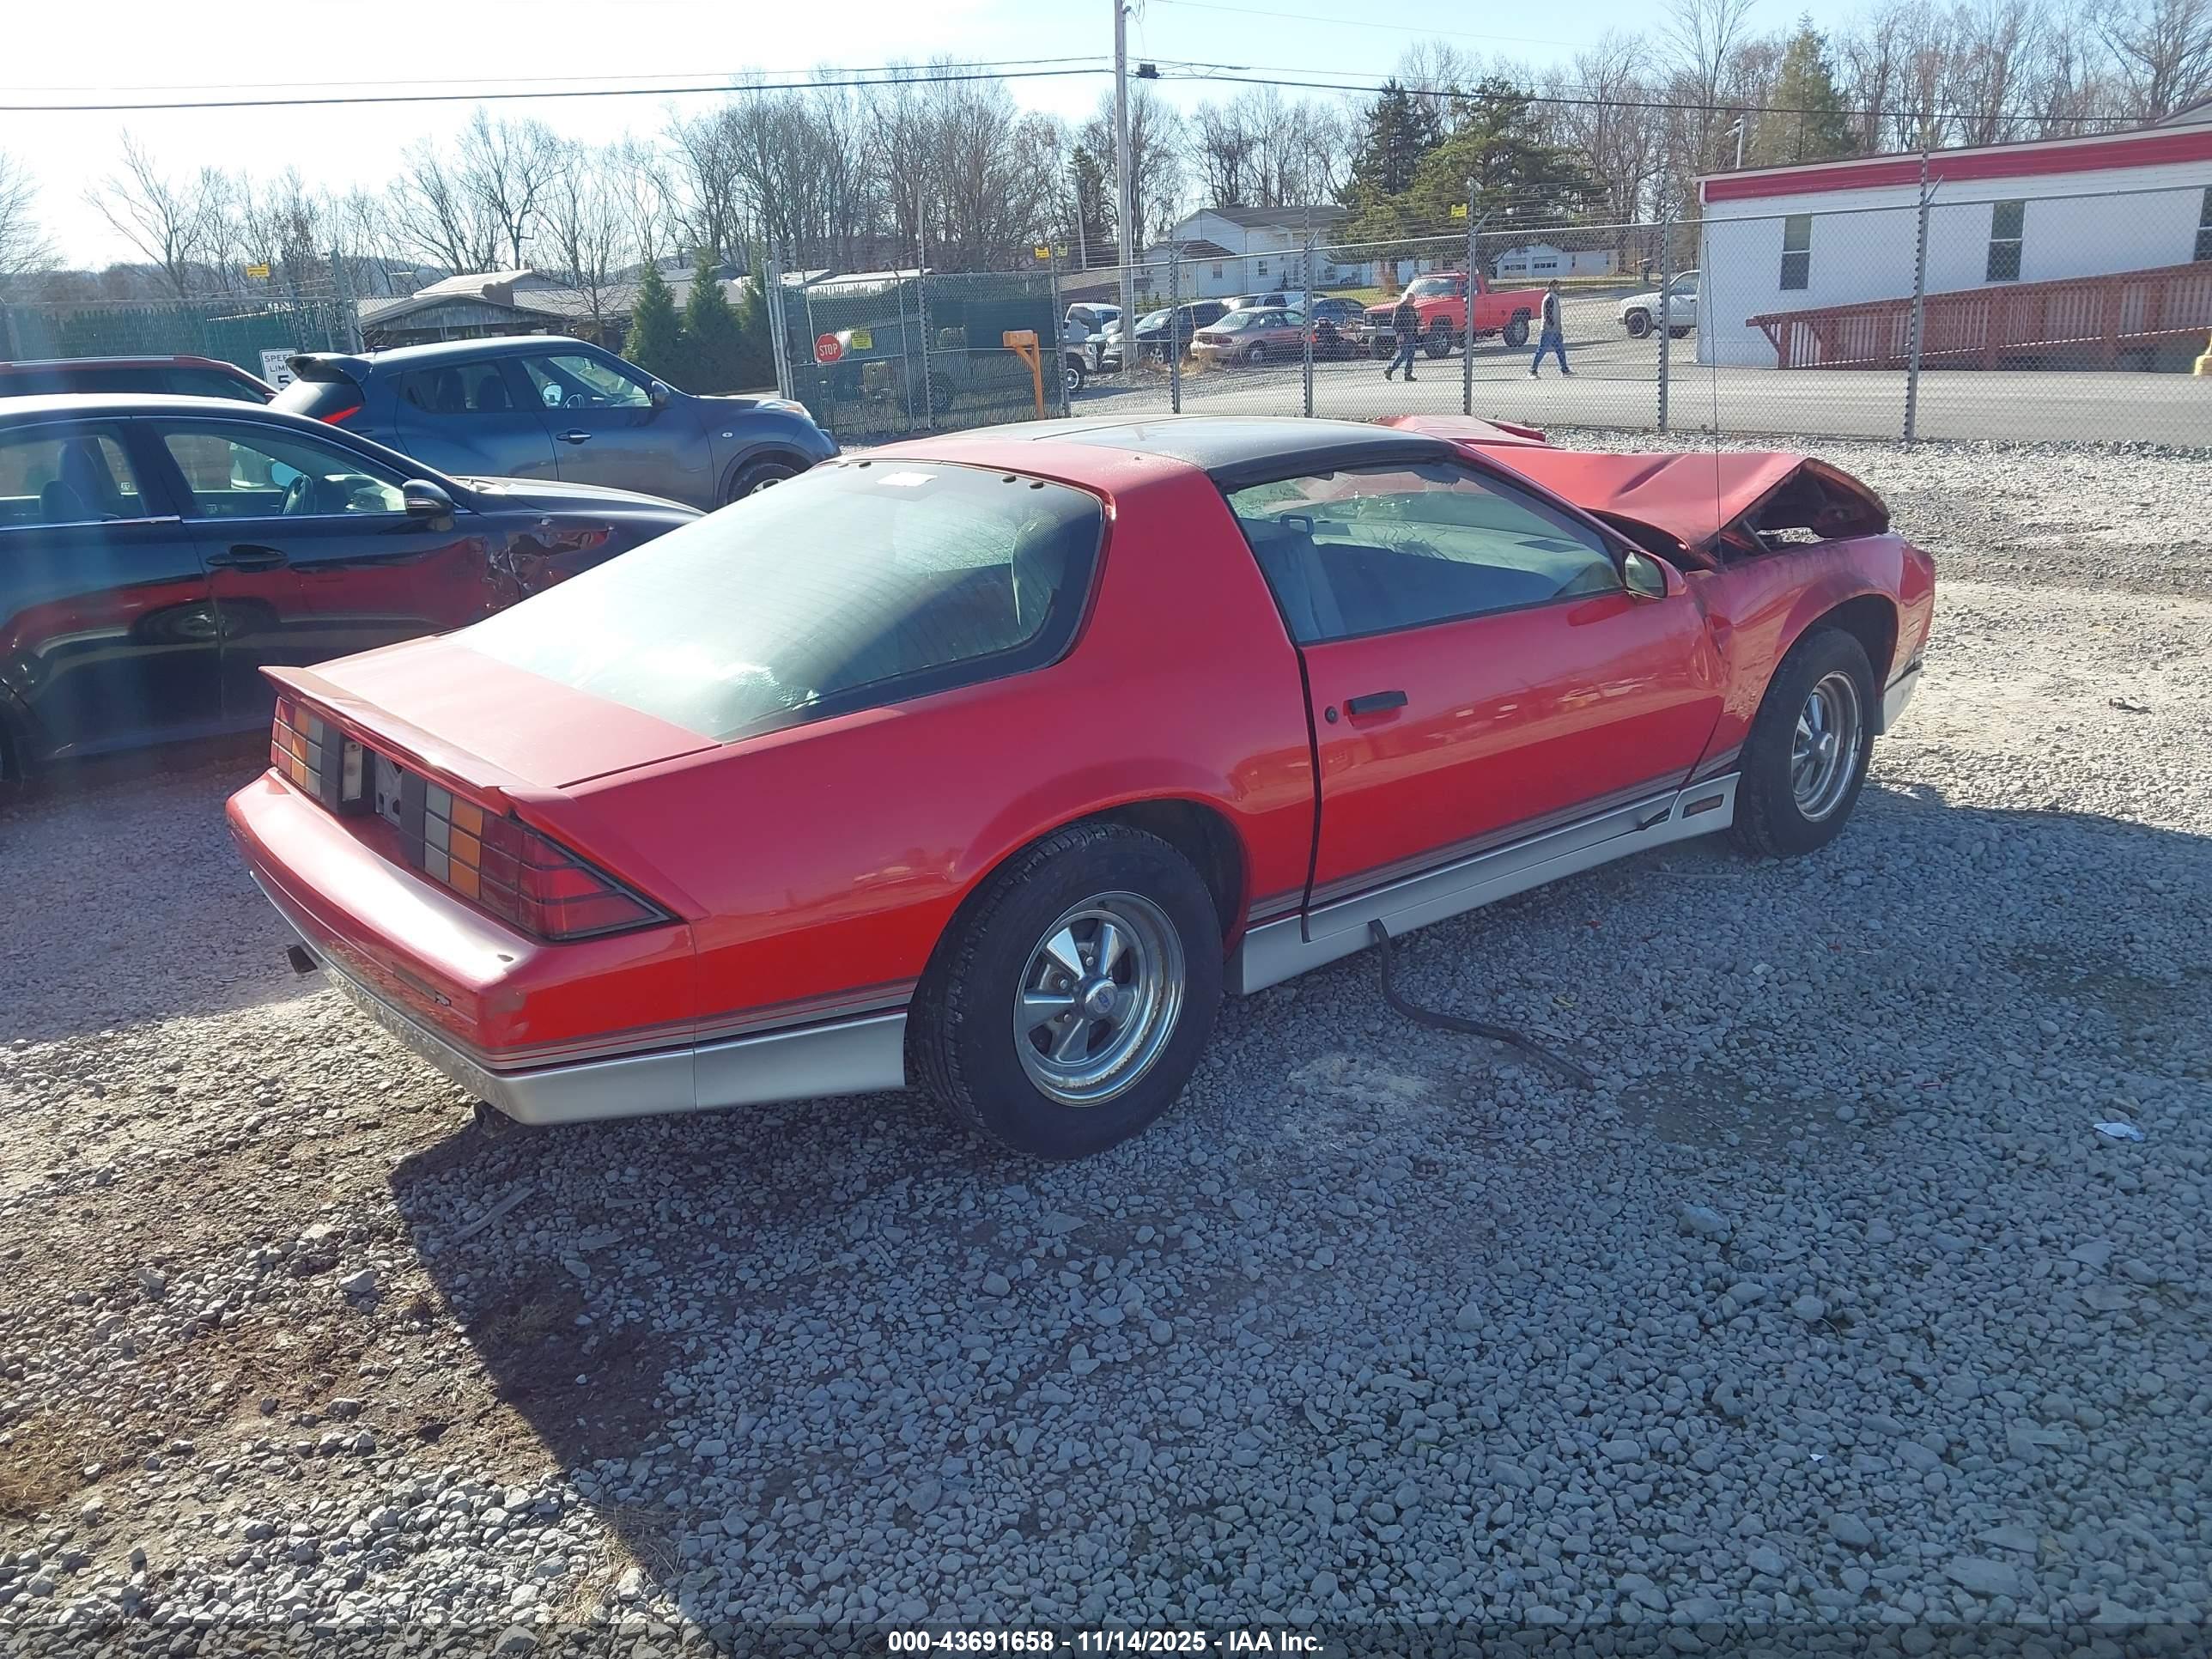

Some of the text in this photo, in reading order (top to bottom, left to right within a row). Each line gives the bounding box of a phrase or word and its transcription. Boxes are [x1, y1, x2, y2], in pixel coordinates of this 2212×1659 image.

[818, 343, 838, 356] STOP
[264, 354, 293, 362] SPEE
[277, 374, 290, 391] 5
